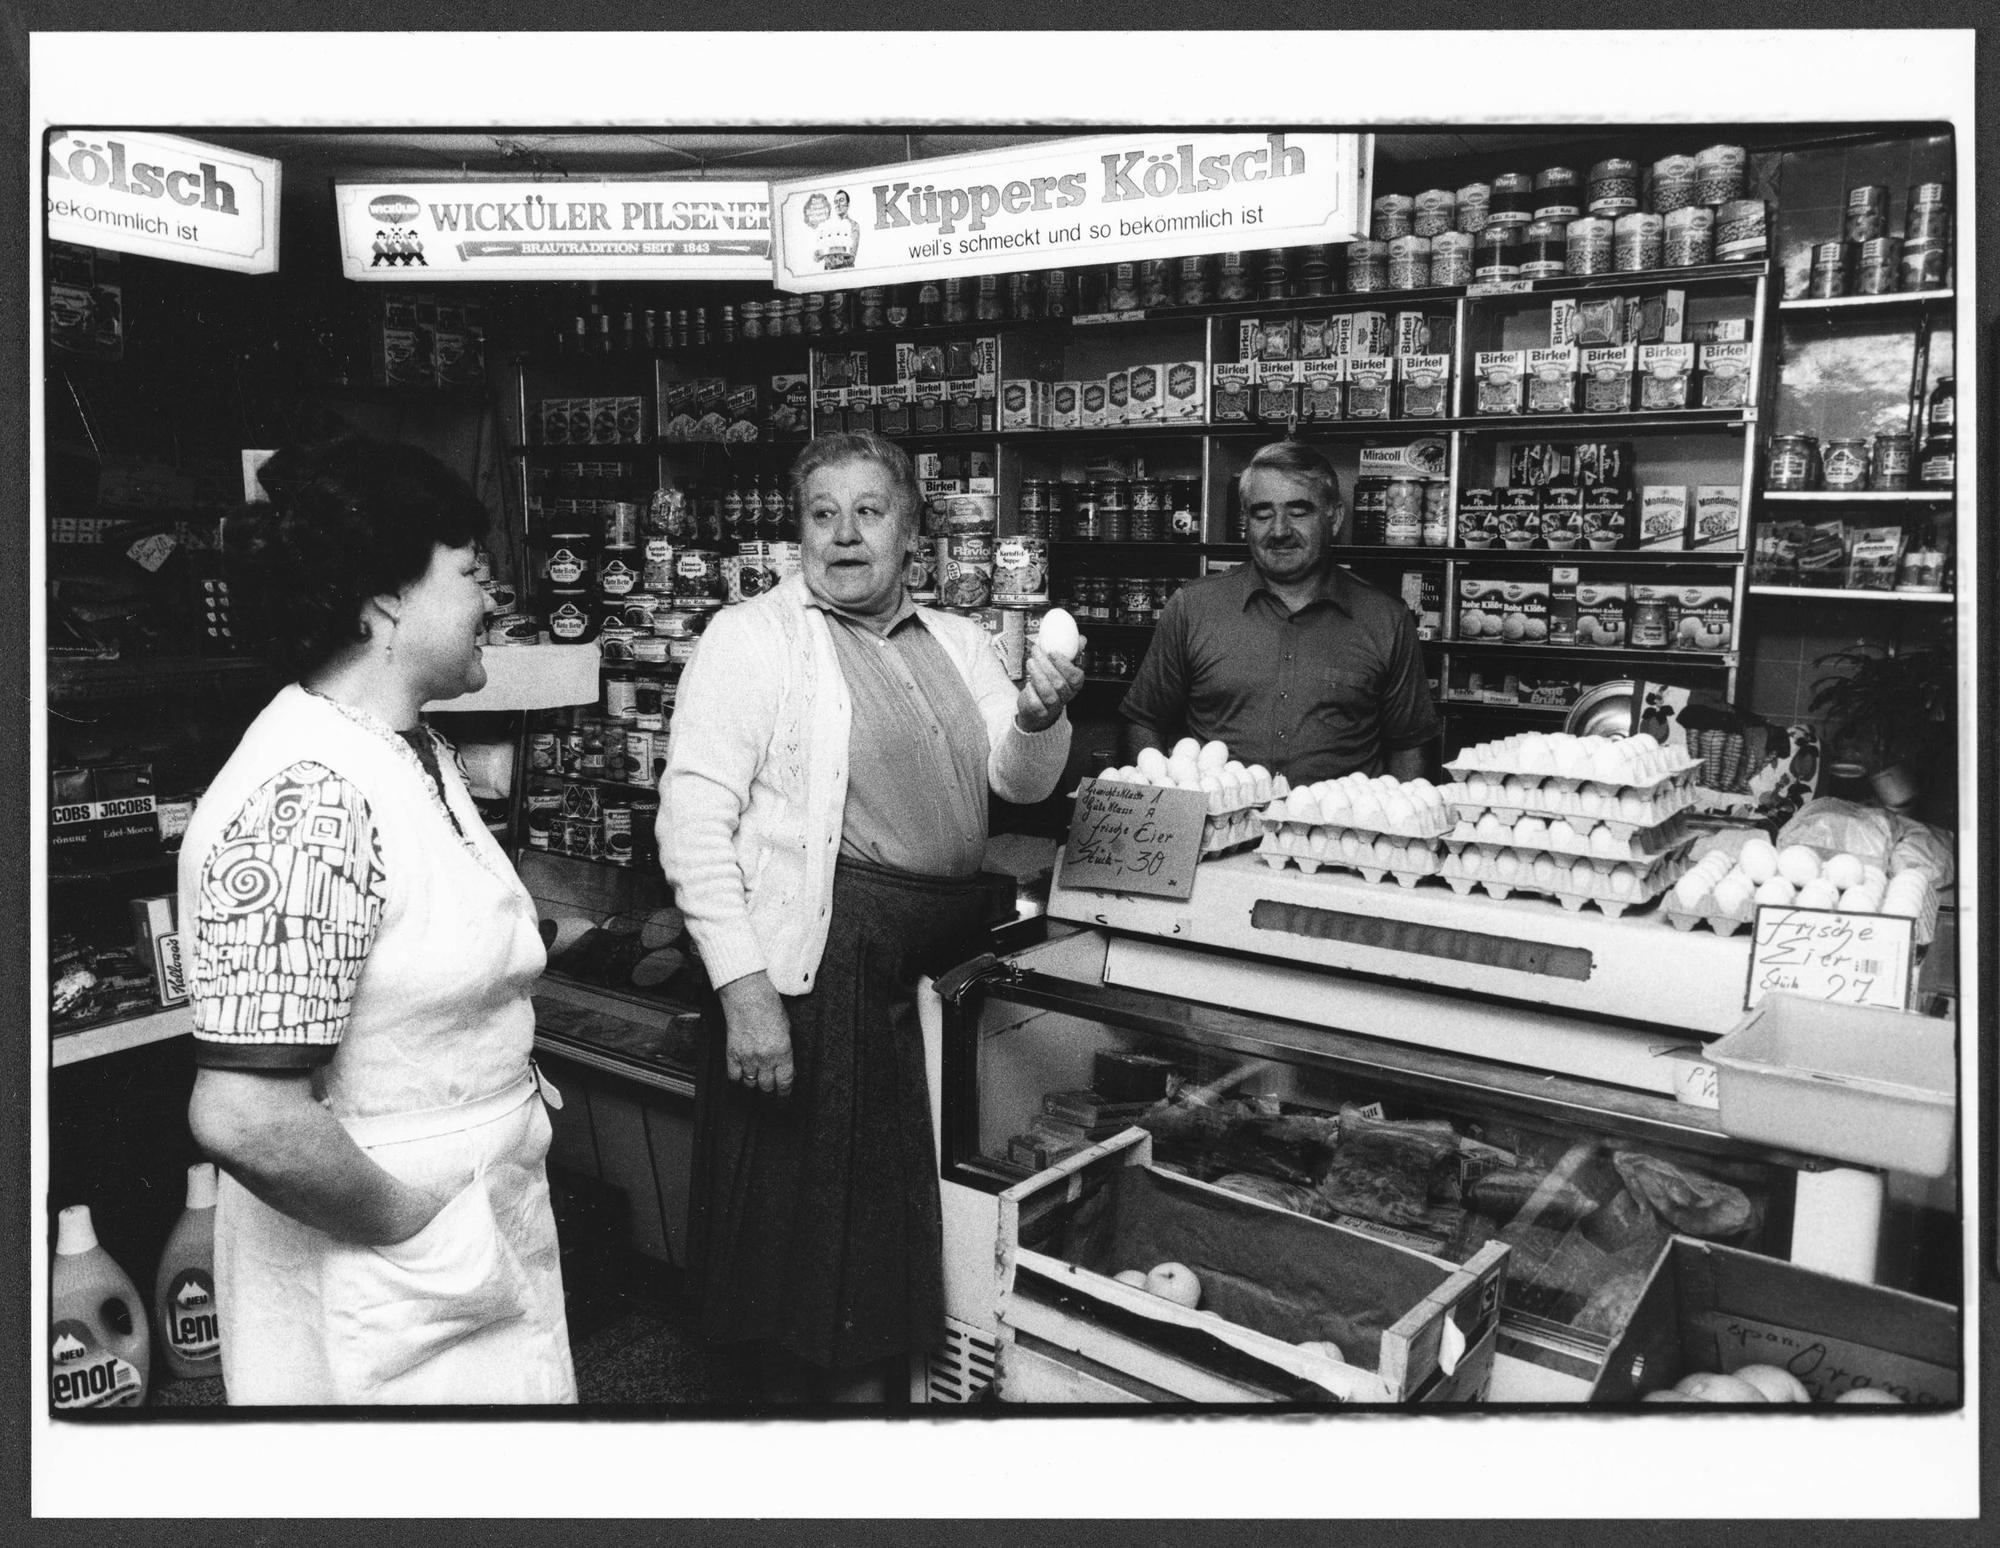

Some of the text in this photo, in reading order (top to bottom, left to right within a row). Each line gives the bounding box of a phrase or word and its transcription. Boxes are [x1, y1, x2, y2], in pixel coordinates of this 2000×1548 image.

[872, 133, 1306, 235] Küppers Kölsch
[428, 194, 609, 232] WICKÜLER
[177, 219, 198, 241] ist
[908, 205, 1264, 259] weil's schmeckt und so bekömmlich ist
[521, 242, 710, 254] BRAUTRADITION SEIT 1843
[1552, 305, 1565, 346] Birkel
[1340, 318, 1350, 356] Birkel
[1369, 316, 1379, 354] Birkel
[1402, 316, 1412, 355] Birkel
[1240, 324, 1250, 361] Birkel
[1532, 350, 1571, 361] Birkel
[1588, 349, 1627, 361] Birkel
[1644, 345, 1687, 358] Birkel
[1706, 345, 1748, 357] Birkel
[985, 341, 994, 374] Birkel
[1406, 357, 1443, 368] Birkel
[1480, 352, 1519, 364] Birkel
[1217, 365, 1249, 375] Birkel
[1260, 362, 1294, 374] Birkel
[1304, 361, 1338, 372] Birkel
[1352, 359, 1386, 370] Birkel
[881, 385, 907, 396] Birkel
[916, 383, 941, 393] Birkel
[950, 380, 976, 391] Birkel
[816, 390, 841, 400] Birkel
[847, 388, 872, 398] Birkel
[926, 481, 957, 492] Birkel
[1461, 600, 1481, 609] Rohe
[1503, 603, 1522, 612] Rohe
[100, 798, 152, 818] JACOBS
[1134, 822, 1174, 843] Eier
[186, 1294, 208, 1306] NEU
[60, 1347, 84, 1361] NEU
[53, 1358, 119, 1404] enor
